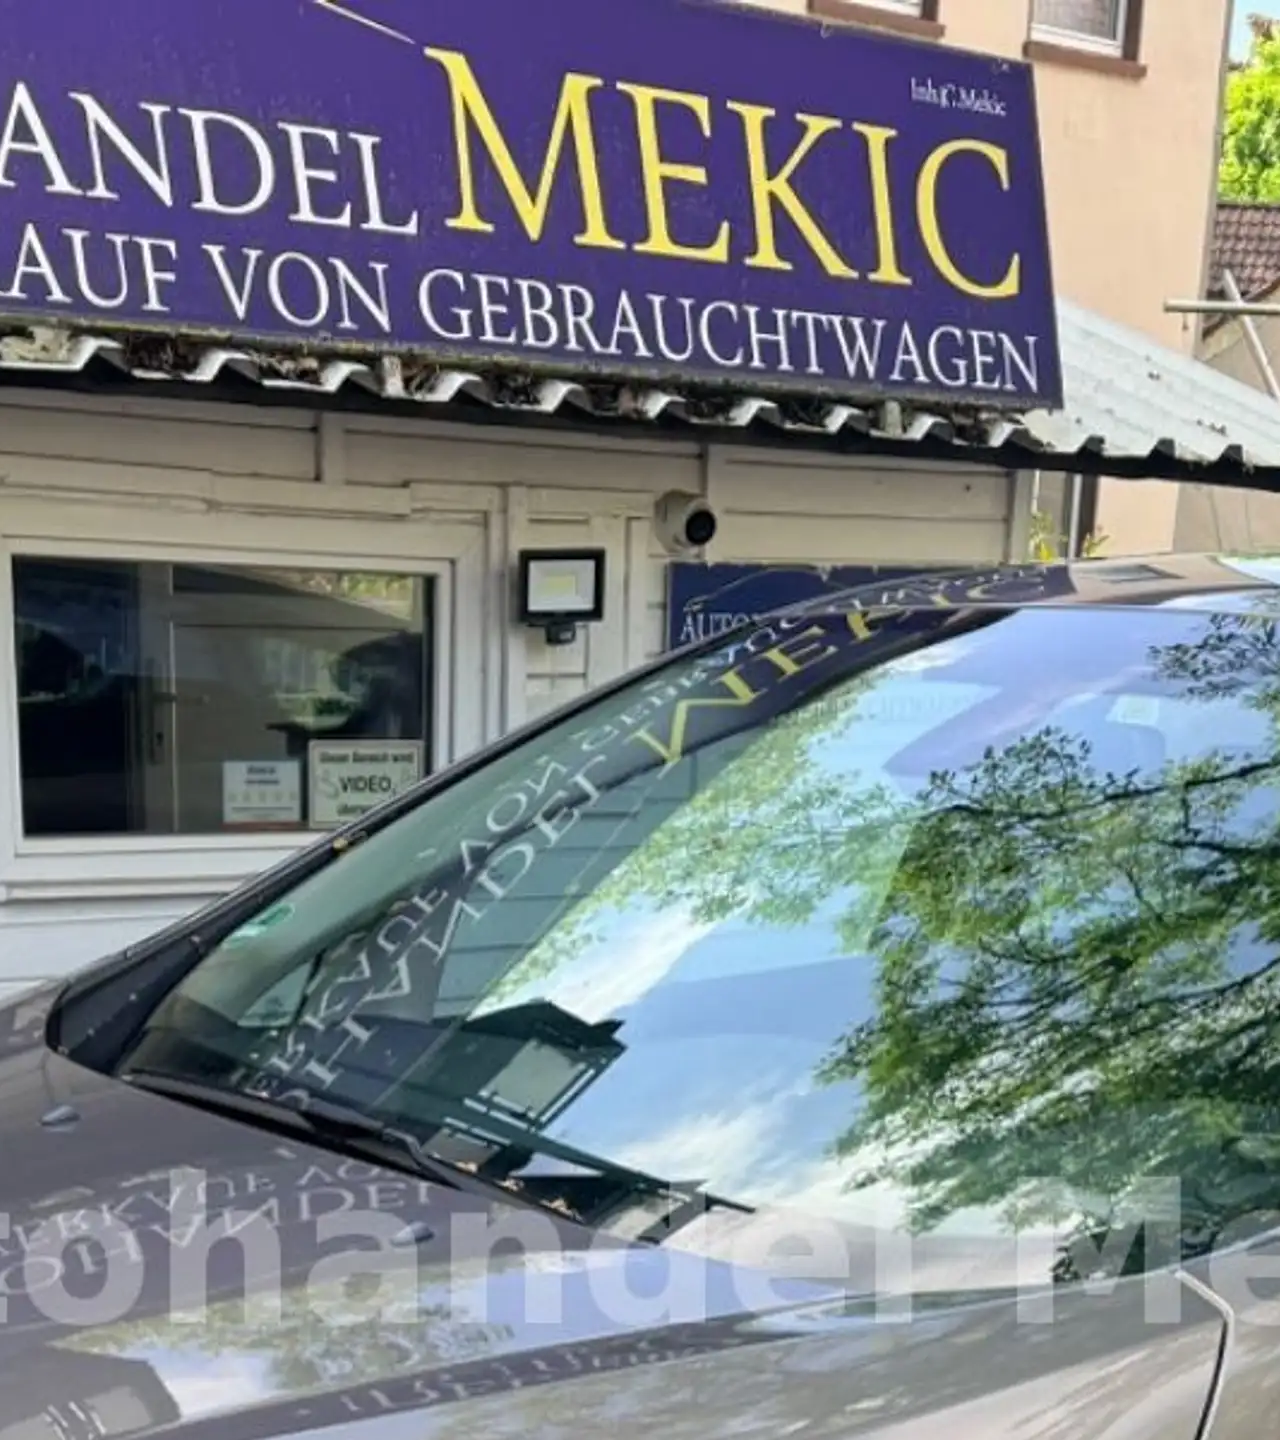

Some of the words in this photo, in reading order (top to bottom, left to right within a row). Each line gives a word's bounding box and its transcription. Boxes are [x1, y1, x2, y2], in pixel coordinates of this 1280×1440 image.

[423, 46, 1021, 300] MEKIC
[202, 242, 393, 335] VON
[417, 268, 1040, 394] GEBRAUCHTWAGEN
